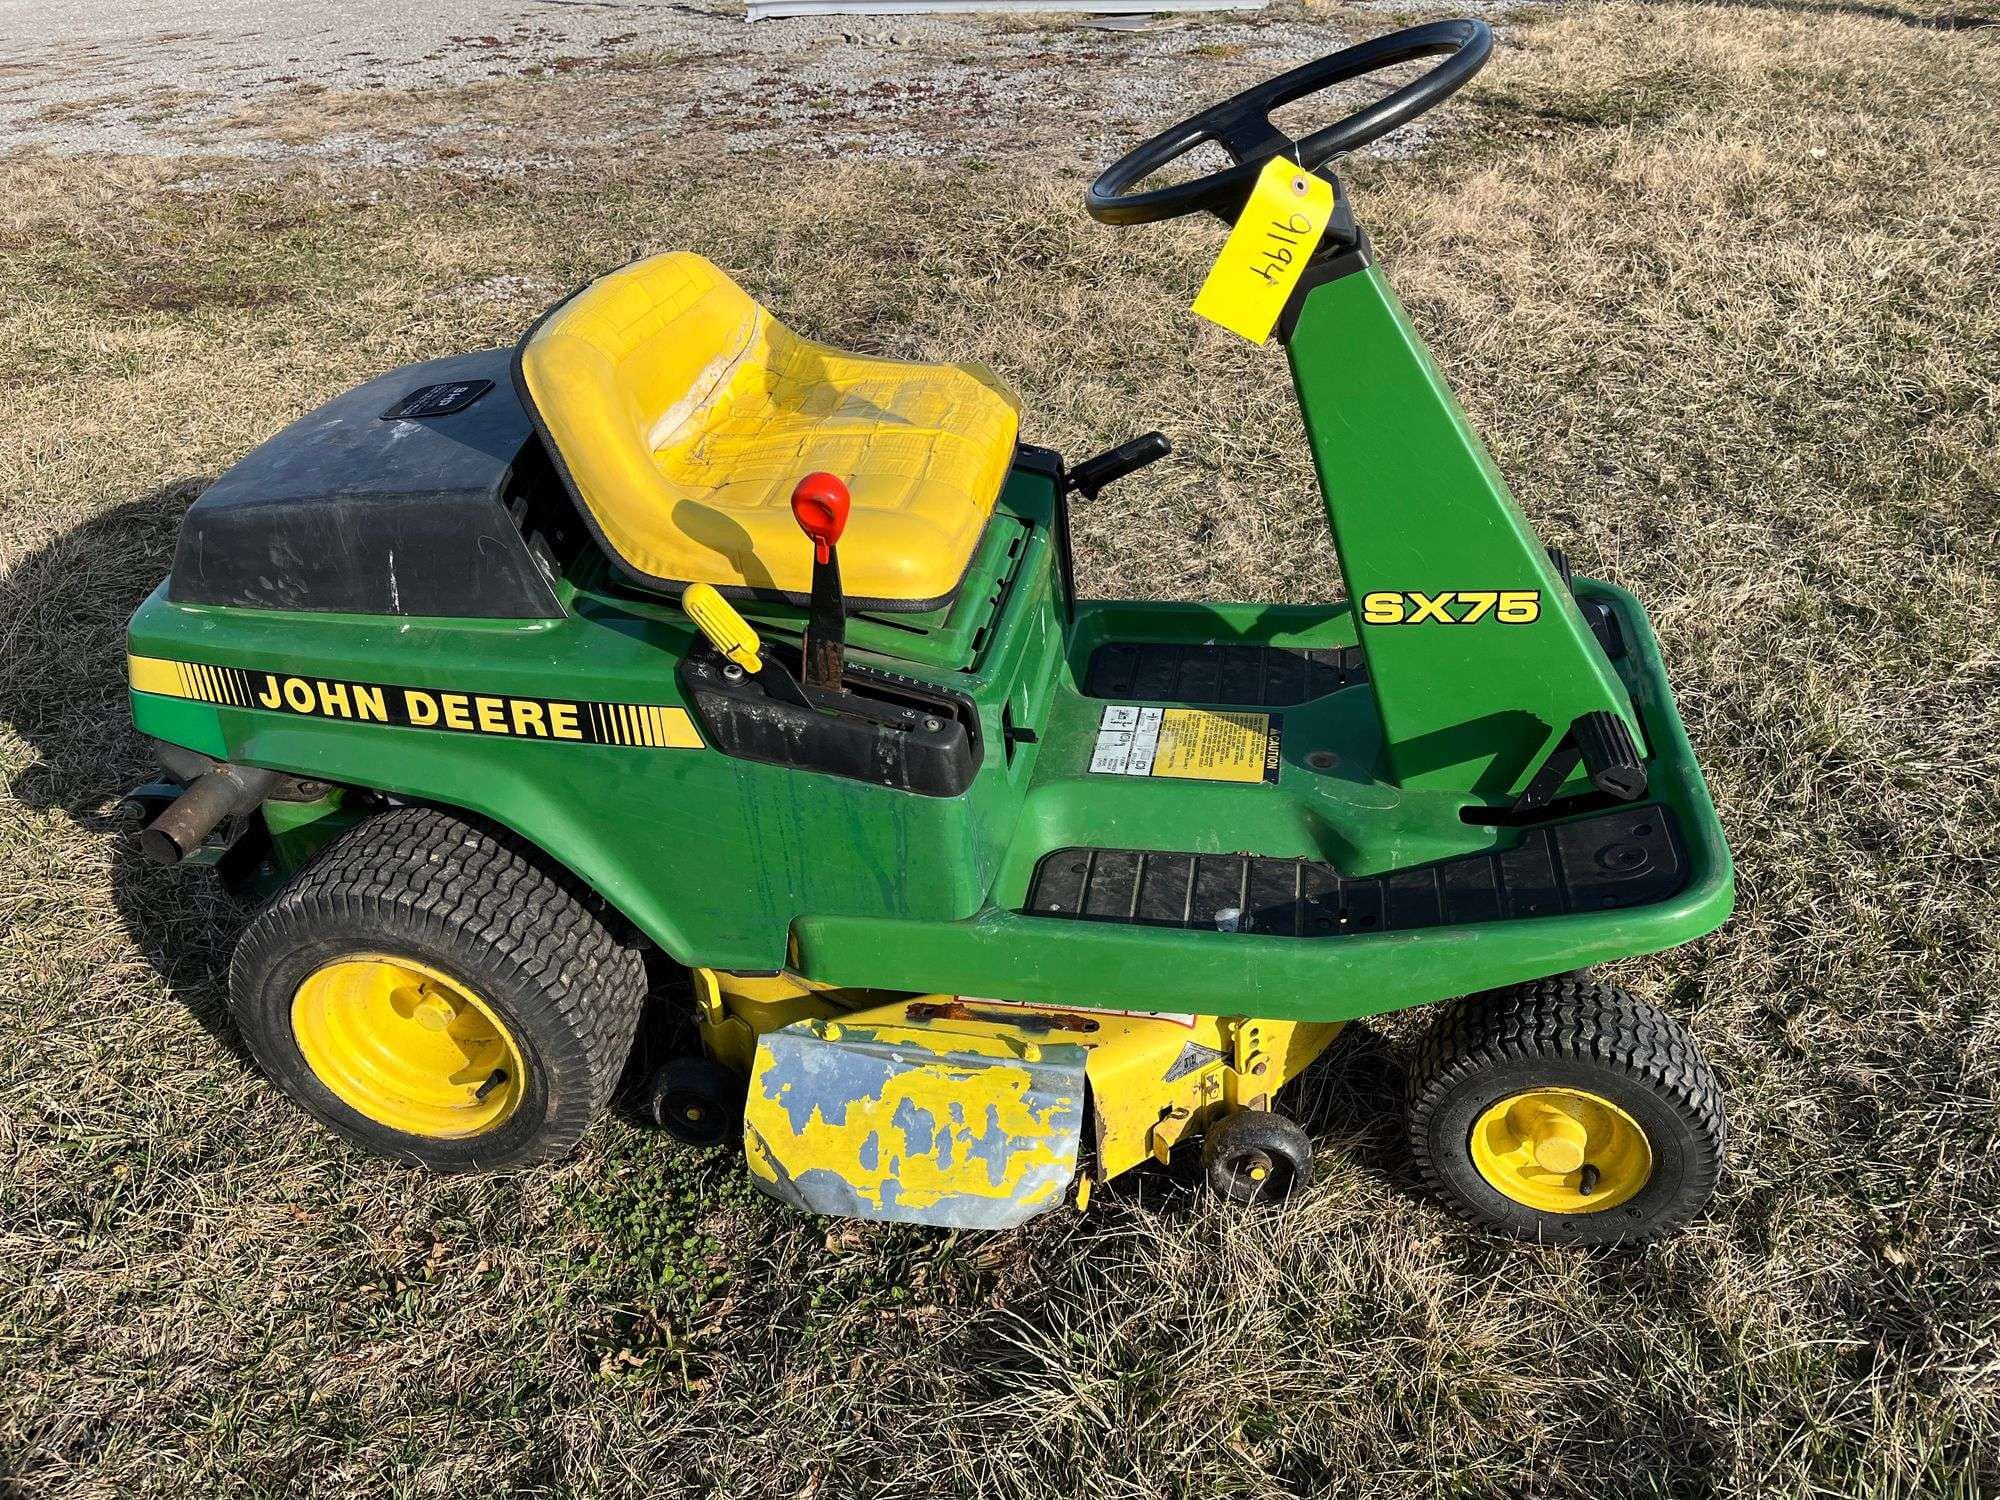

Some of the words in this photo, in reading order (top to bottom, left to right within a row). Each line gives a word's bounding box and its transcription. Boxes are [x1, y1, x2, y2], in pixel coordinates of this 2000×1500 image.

[1249, 213, 1312, 285] 9194
[1362, 590, 1541, 625] SX75
[258, 675, 389, 722] JOHN
[404, 690, 583, 740] DEERE
[1266, 736, 1281, 770] CAUTION
